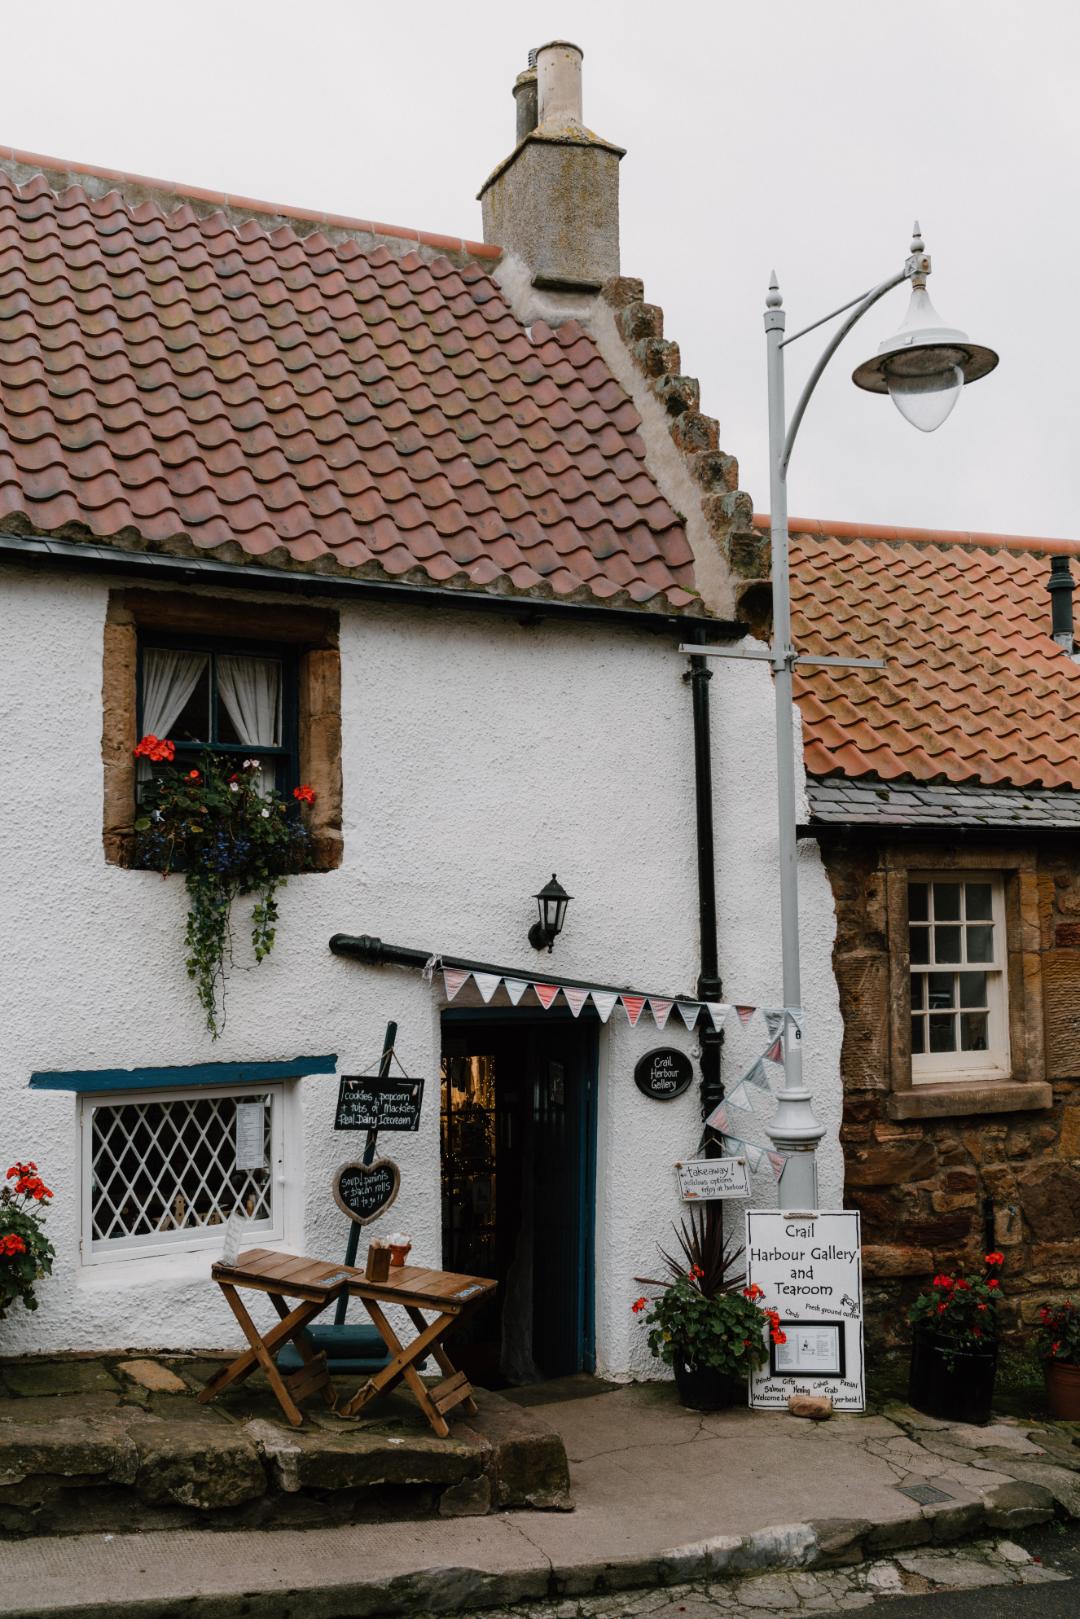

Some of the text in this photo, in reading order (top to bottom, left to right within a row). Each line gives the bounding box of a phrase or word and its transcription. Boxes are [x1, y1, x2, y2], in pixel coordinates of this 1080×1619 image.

[654, 1055, 674, 1068] Crail
[650, 1067, 680, 1080] Harbour
[651, 1078, 677, 1092] Gallery
[344, 1089, 410, 1105] cookies popcorn
[350, 1102, 368, 1113] tubs
[383, 1102, 416, 1113] Mackies
[338, 1113, 355, 1126] Real
[355, 1112, 378, 1129] Dairy
[374, 1181, 391, 1193] rolls
[785, 1222, 815, 1238] Crail
[750, 1244, 857, 1264] Harbour Gallery
[790, 1265, 814, 1280] and
[774, 1282, 833, 1296] Tearoom
[805, 1302, 821, 1312] Fresh
[821, 1307, 842, 1317] ground
[782, 1377, 796, 1385] Gifts
[752, 1393, 780, 1401] Welcome
[825, 1386, 839, 1394] Crab
